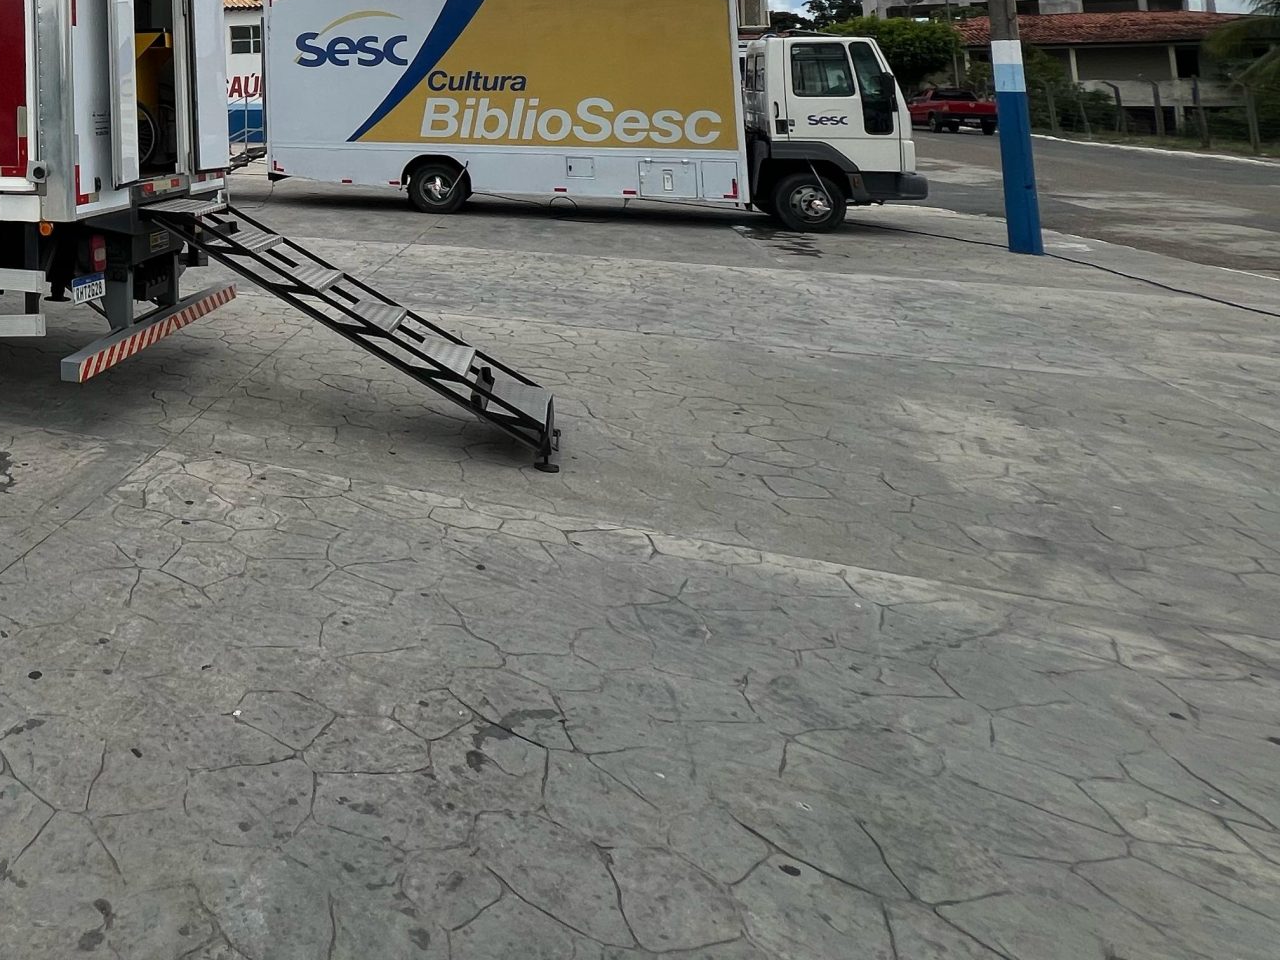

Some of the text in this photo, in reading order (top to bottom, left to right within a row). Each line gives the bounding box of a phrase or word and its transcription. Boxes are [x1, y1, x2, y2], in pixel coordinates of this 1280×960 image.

[295, 32, 408, 67] Sesc
[226, 73, 262, 98] AÚ
[428, 71, 527, 91] Cultura
[421, 97, 722, 145] BiblioSesc
[807, 114, 849, 126] Sesc
